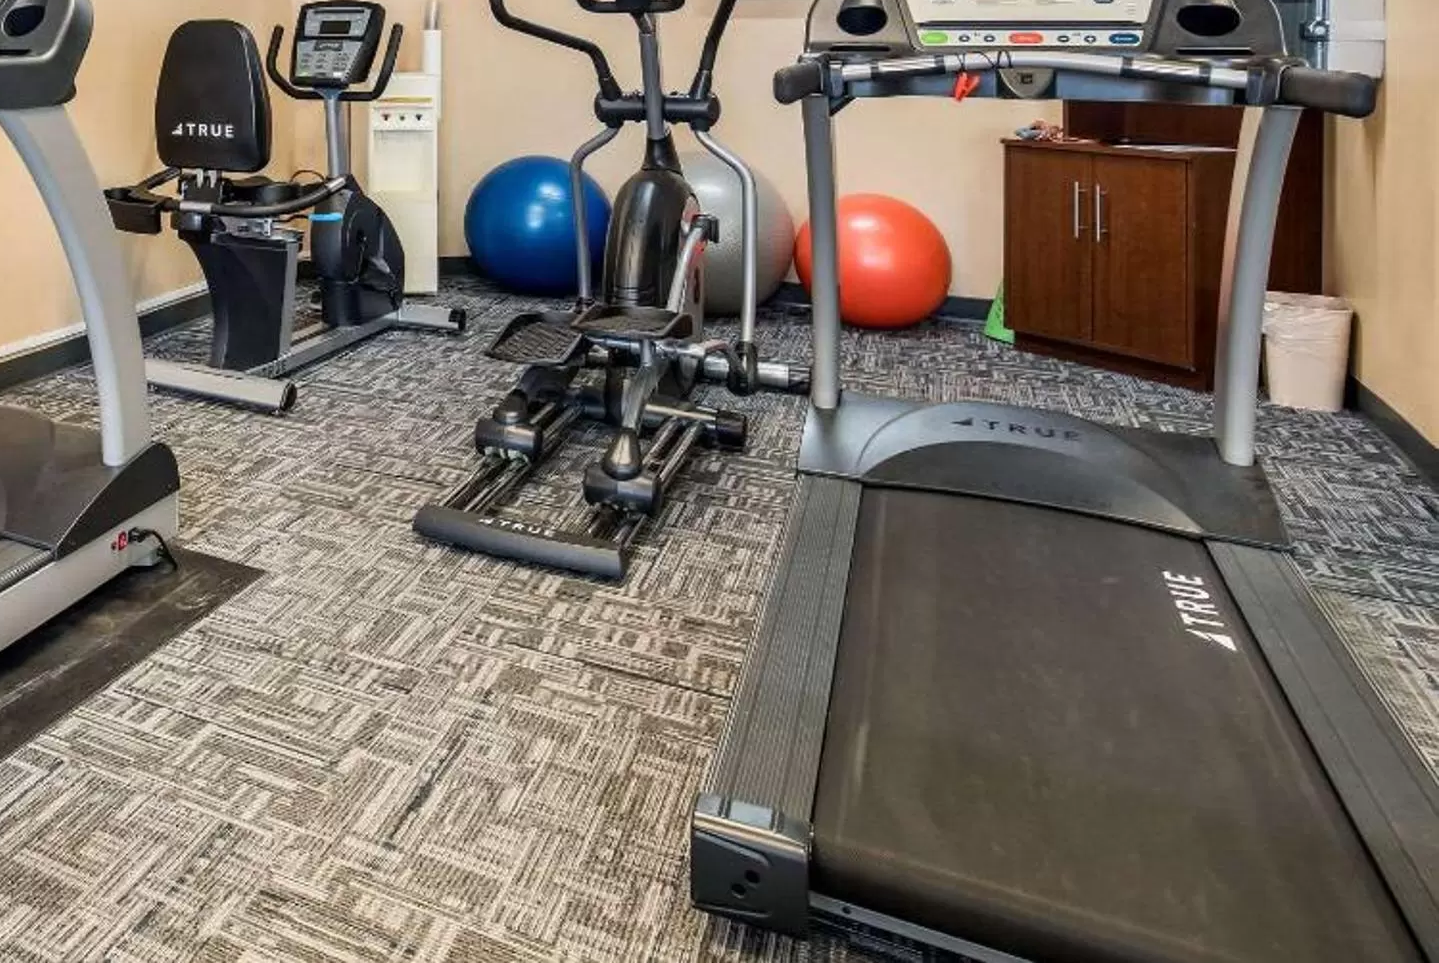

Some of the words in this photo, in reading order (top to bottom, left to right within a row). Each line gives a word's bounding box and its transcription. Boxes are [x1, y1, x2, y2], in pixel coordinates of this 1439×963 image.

[186, 123, 234, 138] TRUE
[982, 419, 1080, 441] TRUE
[500, 518, 556, 538] TRUE
[1162, 571, 1225, 628] TRUE
